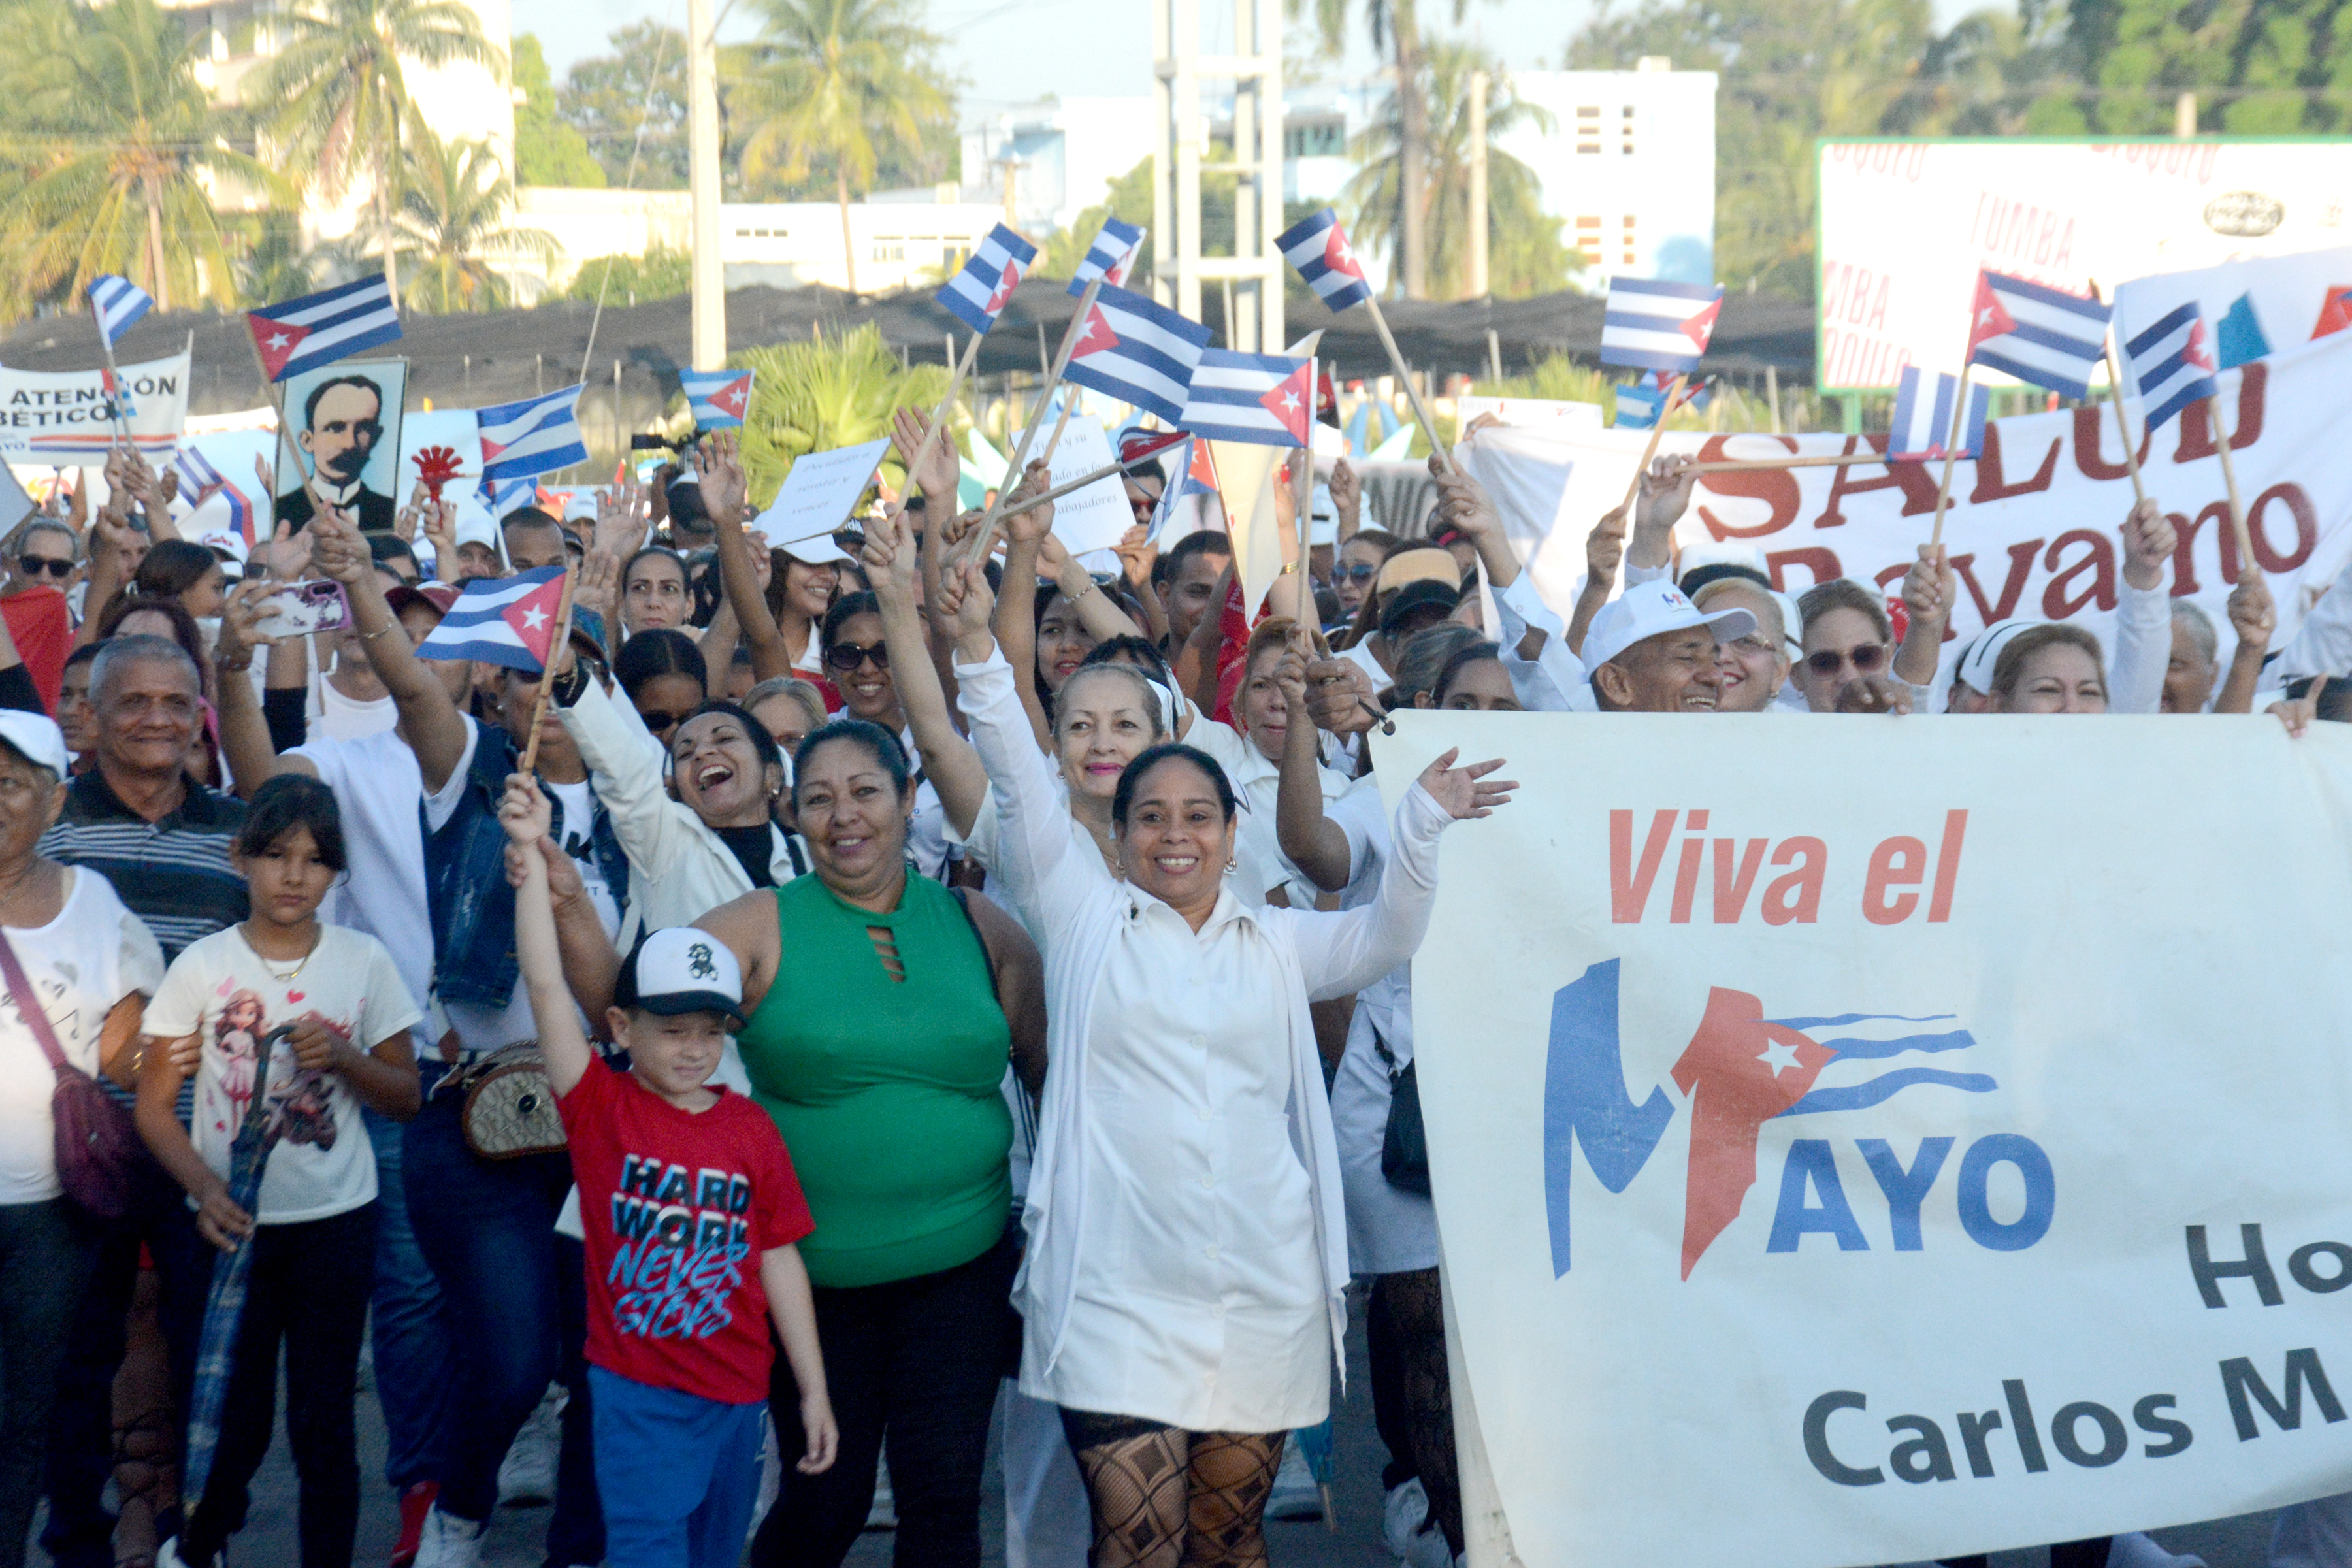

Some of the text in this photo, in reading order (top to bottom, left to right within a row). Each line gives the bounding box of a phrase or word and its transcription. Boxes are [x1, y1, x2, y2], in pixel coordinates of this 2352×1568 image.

[1969, 190, 2075, 272] TUMBA
[11, 374, 177, 405] ATENÓN
[1697, 361, 2269, 542] SALUD
[1057, 494, 1117, 514] abajadores
[1609, 809, 1969, 926] Viva el
[620, 1152, 751, 1215] HARD
[611, 1191, 749, 1250] WORK
[607, 1228, 750, 1296] NEVER
[2185, 1222, 2352, 1309] Ho
[613, 1286, 734, 1339] STOPS
[1803, 1347, 2349, 1487] Carlos M
